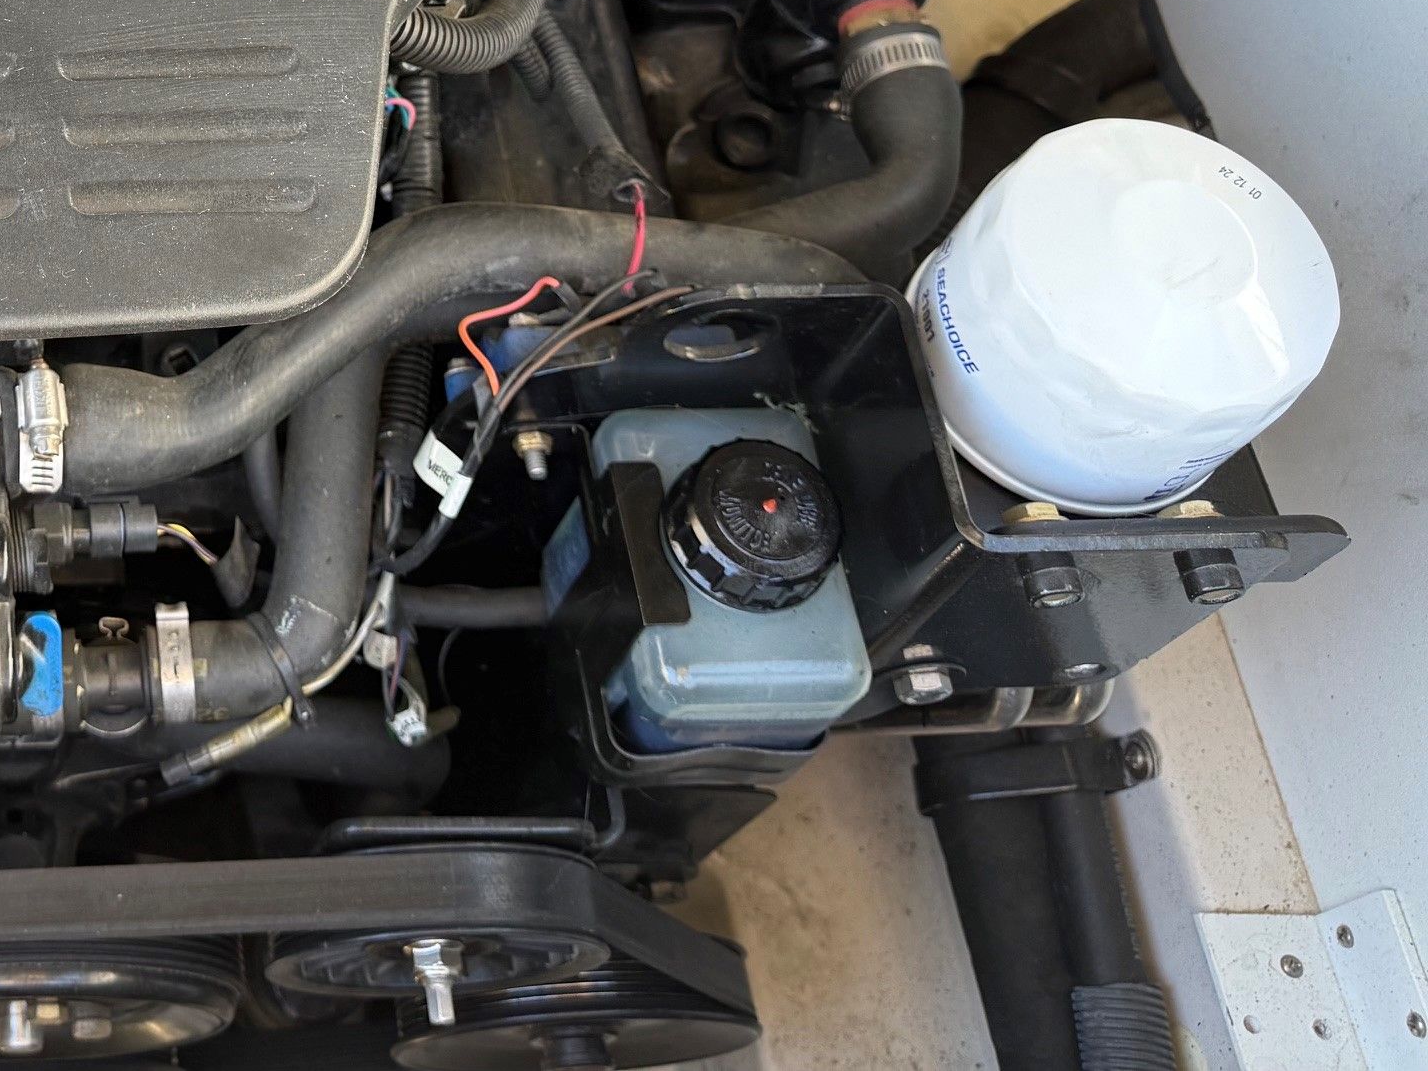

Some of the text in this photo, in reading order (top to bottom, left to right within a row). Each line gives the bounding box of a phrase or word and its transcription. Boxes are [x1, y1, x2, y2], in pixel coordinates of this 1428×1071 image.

[1218, 166, 1262, 200] 01 12 24
[937, 267, 980, 374] SEACHOICE
